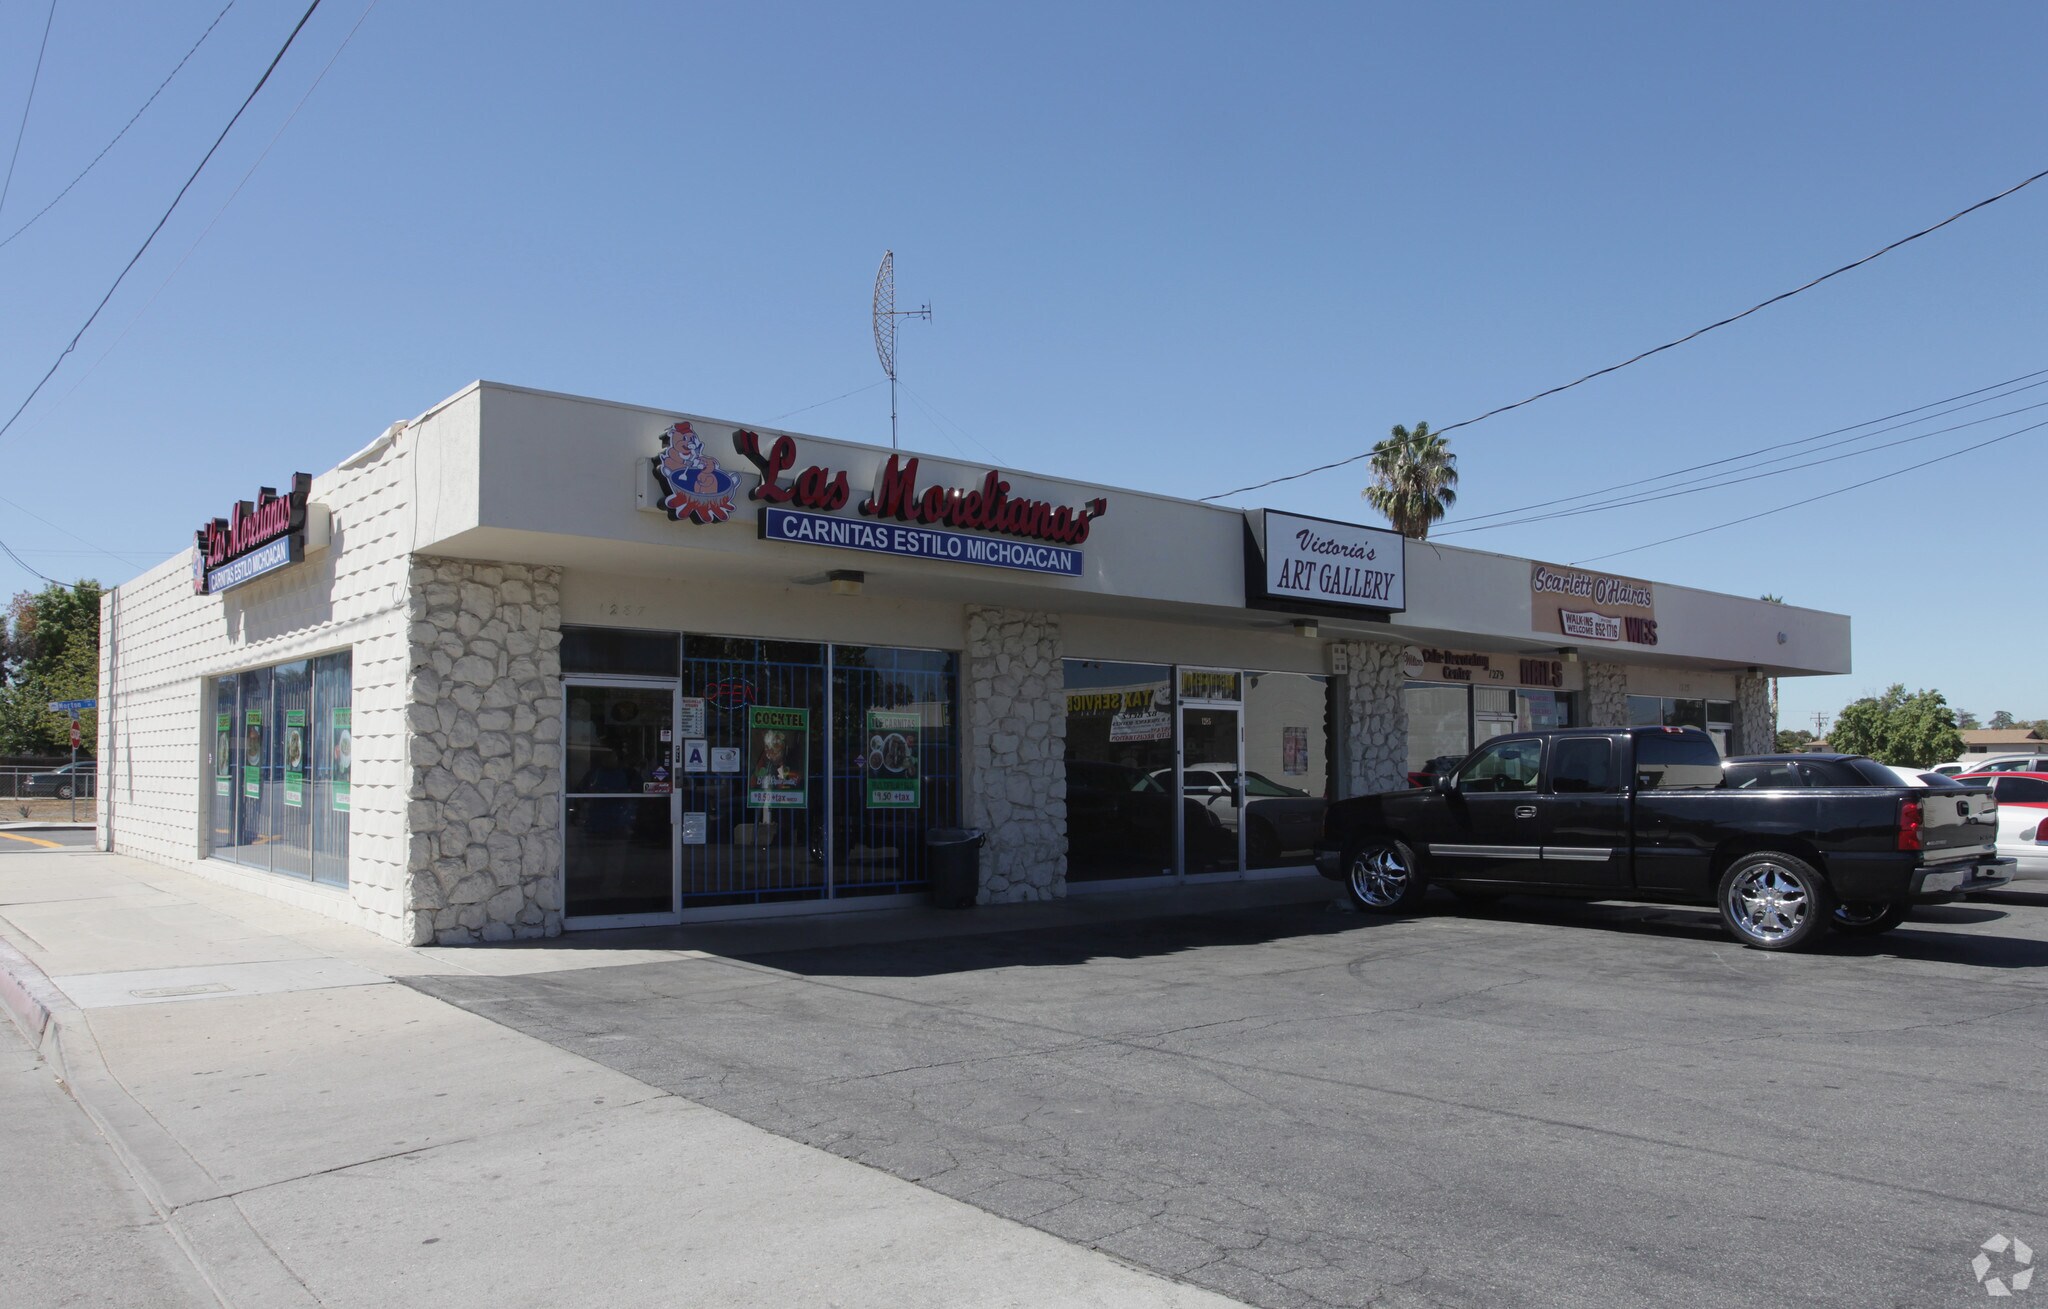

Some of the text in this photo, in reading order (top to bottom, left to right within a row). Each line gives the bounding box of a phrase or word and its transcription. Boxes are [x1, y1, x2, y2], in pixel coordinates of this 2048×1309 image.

[782, 514, 1072, 572] CARNITAS ESTILO MICHOACAN
[1295, 528, 1377, 561] Victoria's
[210, 541, 286, 592] CARNITAS ESTILO MICHOACAN
[1277, 558, 1395, 601] ART GALLERY
[1534, 566, 1652, 607] Scarlett O'Haira's
[1567, 624, 1594, 636] WELCOME
[1624, 616, 1658, 646] WIGS
[1488, 669, 1504, 680] 1279
[754, 712, 804, 726] COCKTEL
[689, 748, 703, 763] A
